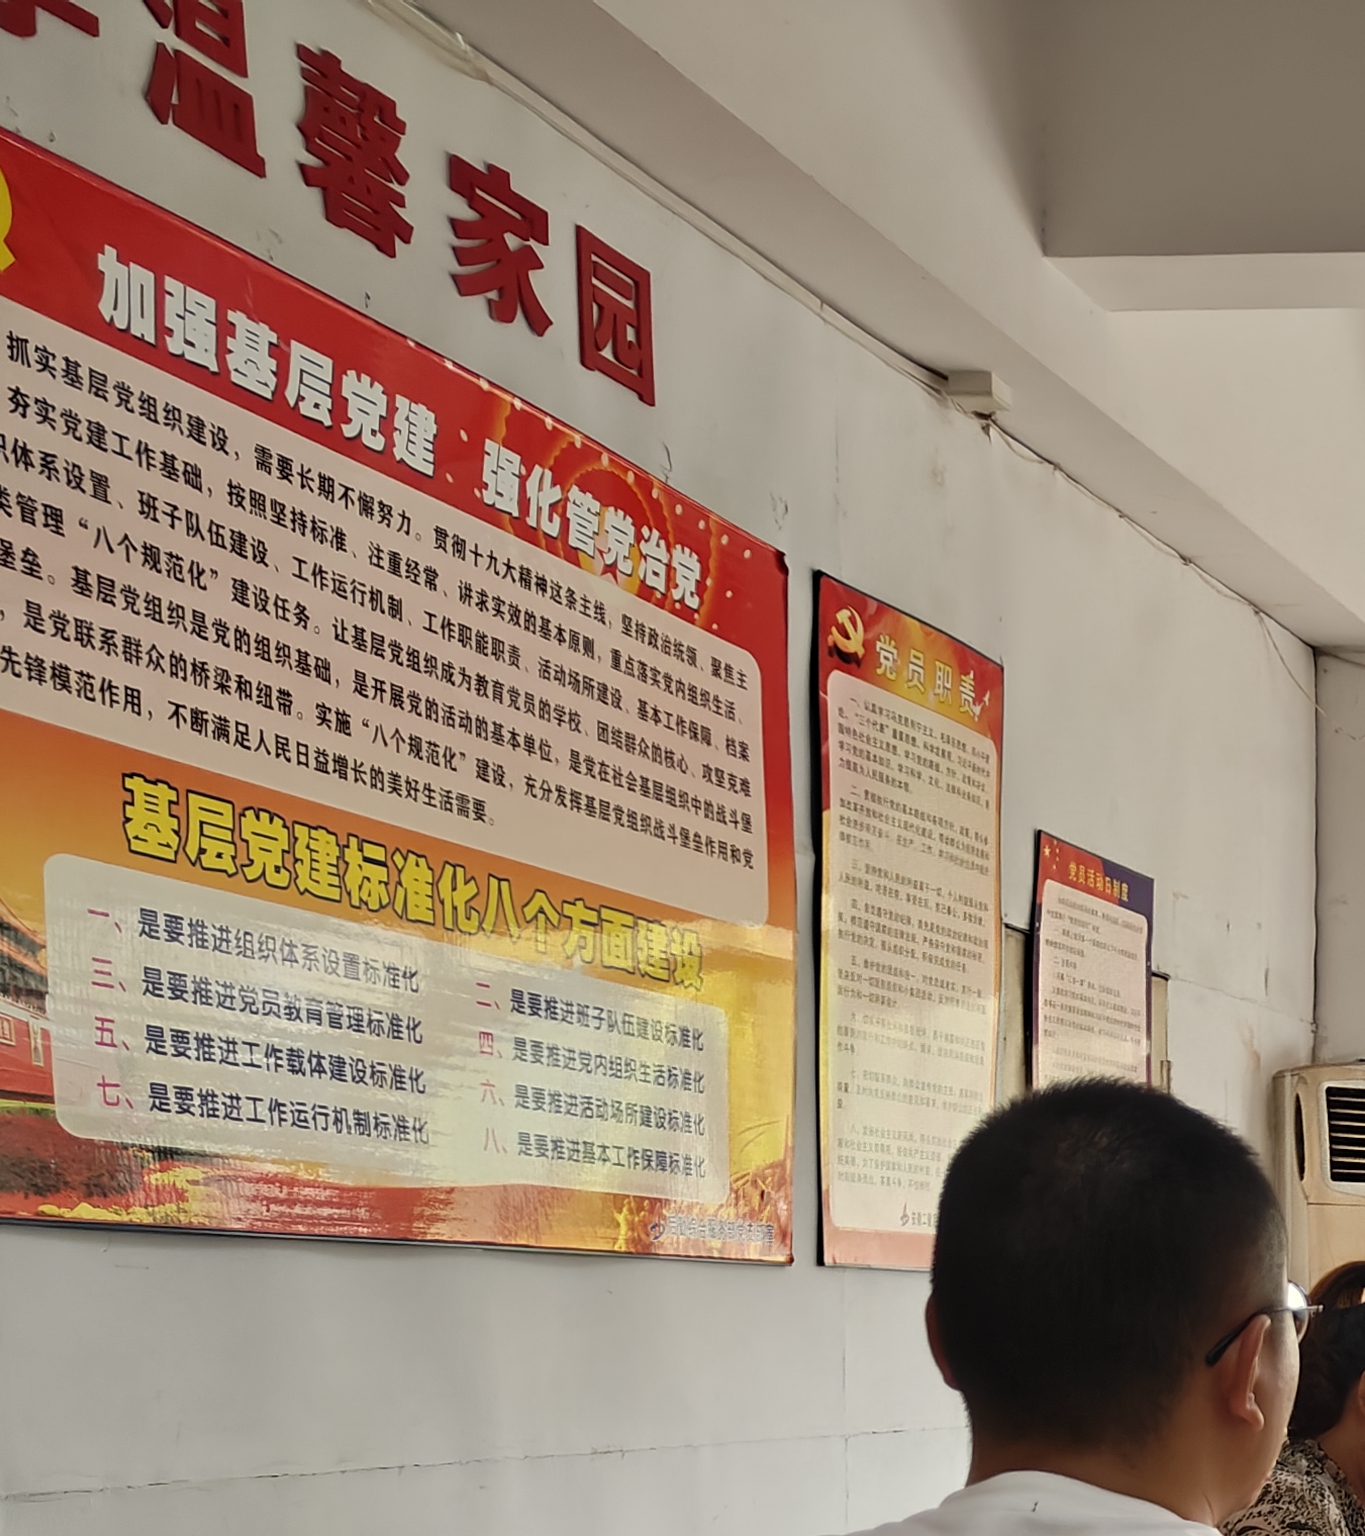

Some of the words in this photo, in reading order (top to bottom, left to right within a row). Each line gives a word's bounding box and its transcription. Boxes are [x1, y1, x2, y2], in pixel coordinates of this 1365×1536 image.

[0, 0, 656, 407] 温馨家园
[98, 245, 438, 480] 加强基层党建
[482, 437, 702, 612] 强化管党治党
[875, 635, 980, 718] 党员职责
[122, 773, 704, 991] 基层党建标准化八个方面建设
